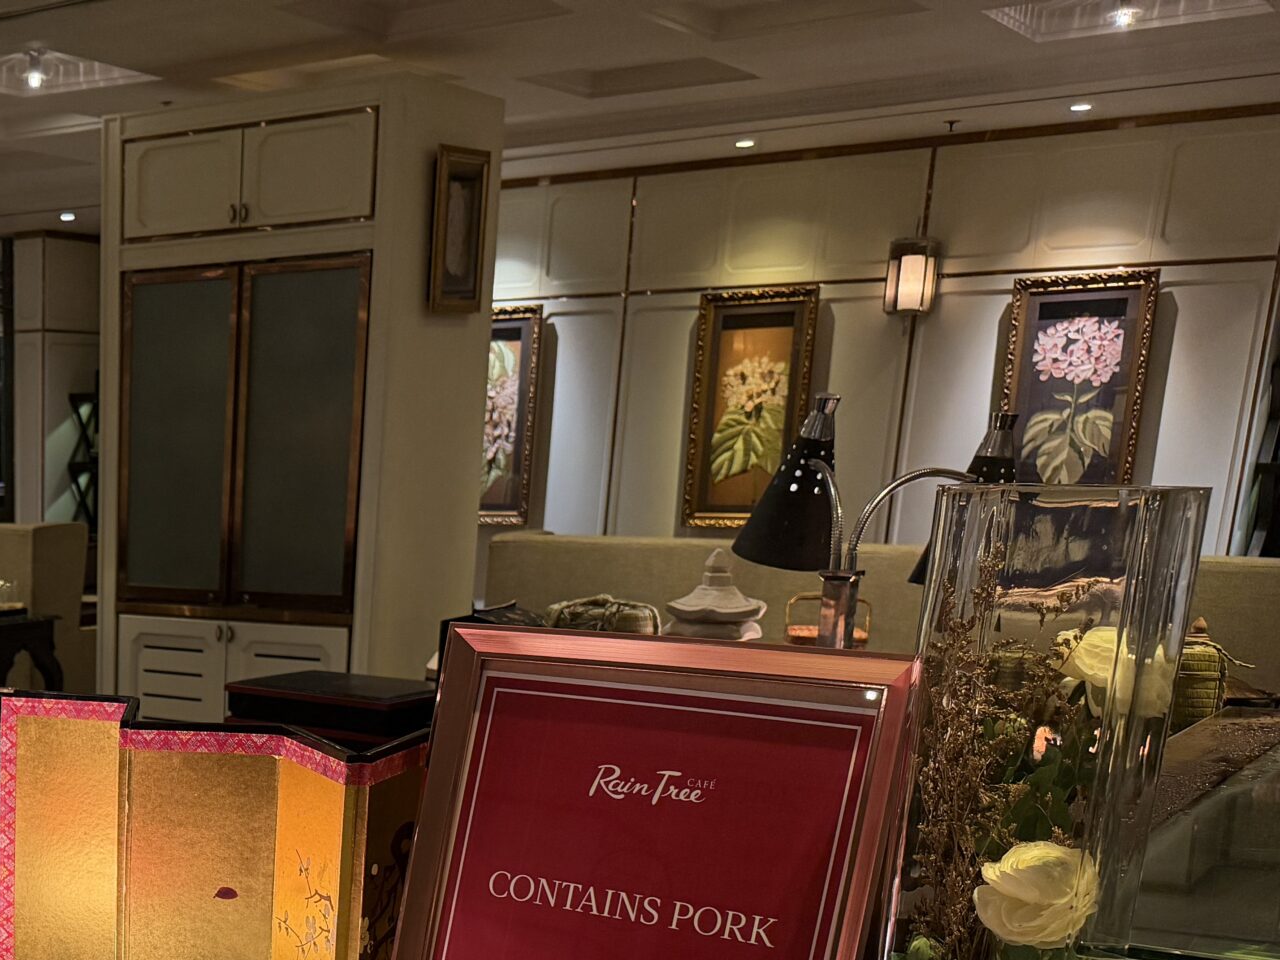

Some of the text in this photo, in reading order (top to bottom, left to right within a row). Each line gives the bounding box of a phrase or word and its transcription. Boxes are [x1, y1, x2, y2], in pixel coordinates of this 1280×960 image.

[588, 764, 706, 806] Rain Tree
[687, 778, 717, 790] CAFÉ
[488, 870, 778, 948] CONTAINS PORK
